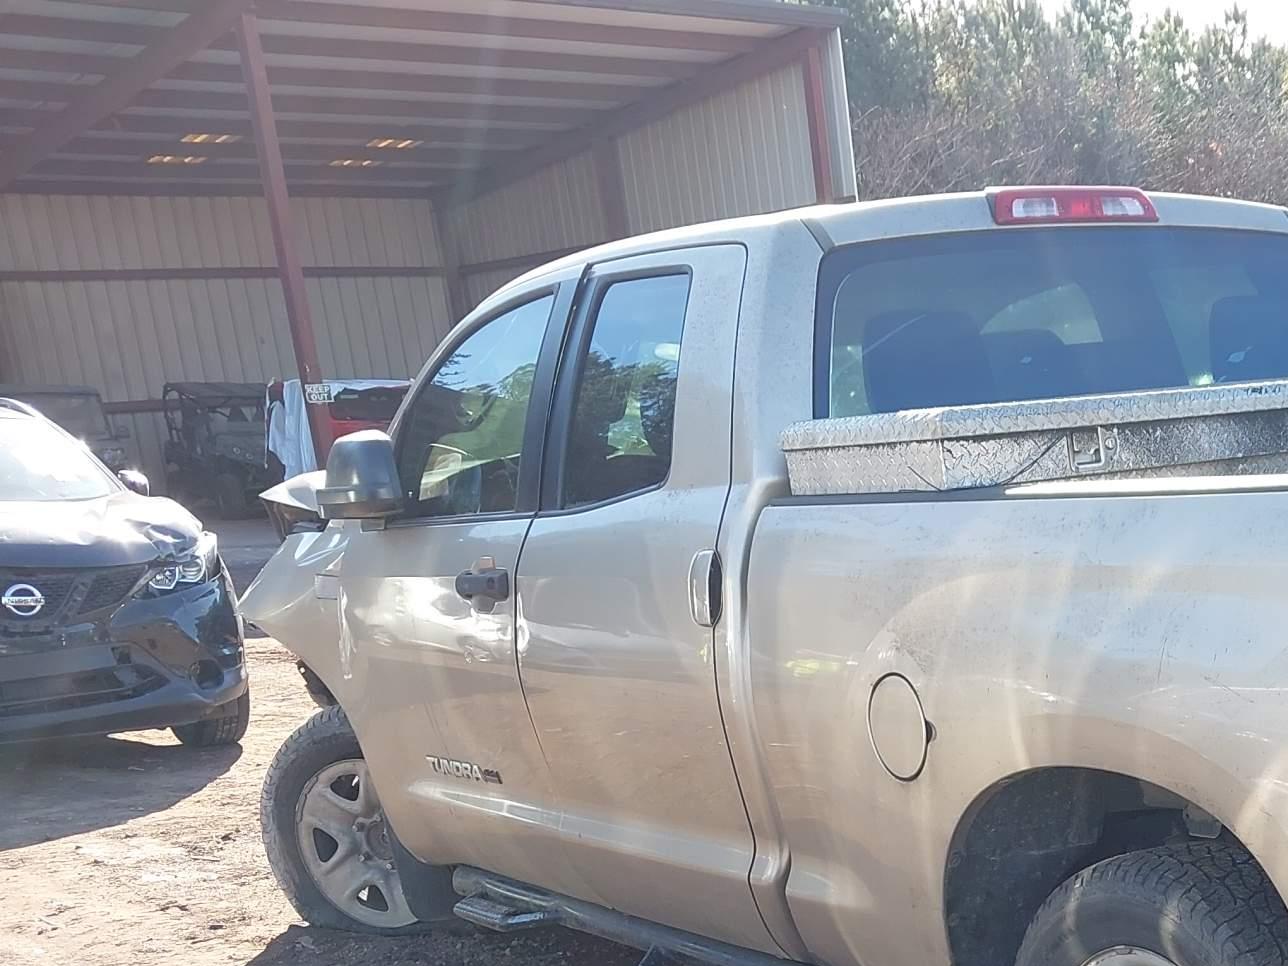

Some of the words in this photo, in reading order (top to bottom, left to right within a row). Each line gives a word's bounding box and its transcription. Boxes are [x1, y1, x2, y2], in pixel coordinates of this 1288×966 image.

[306, 385, 330, 393] KEEP
[310, 393, 329, 401] OUT
[425, 755, 486, 784] TUNDRA
